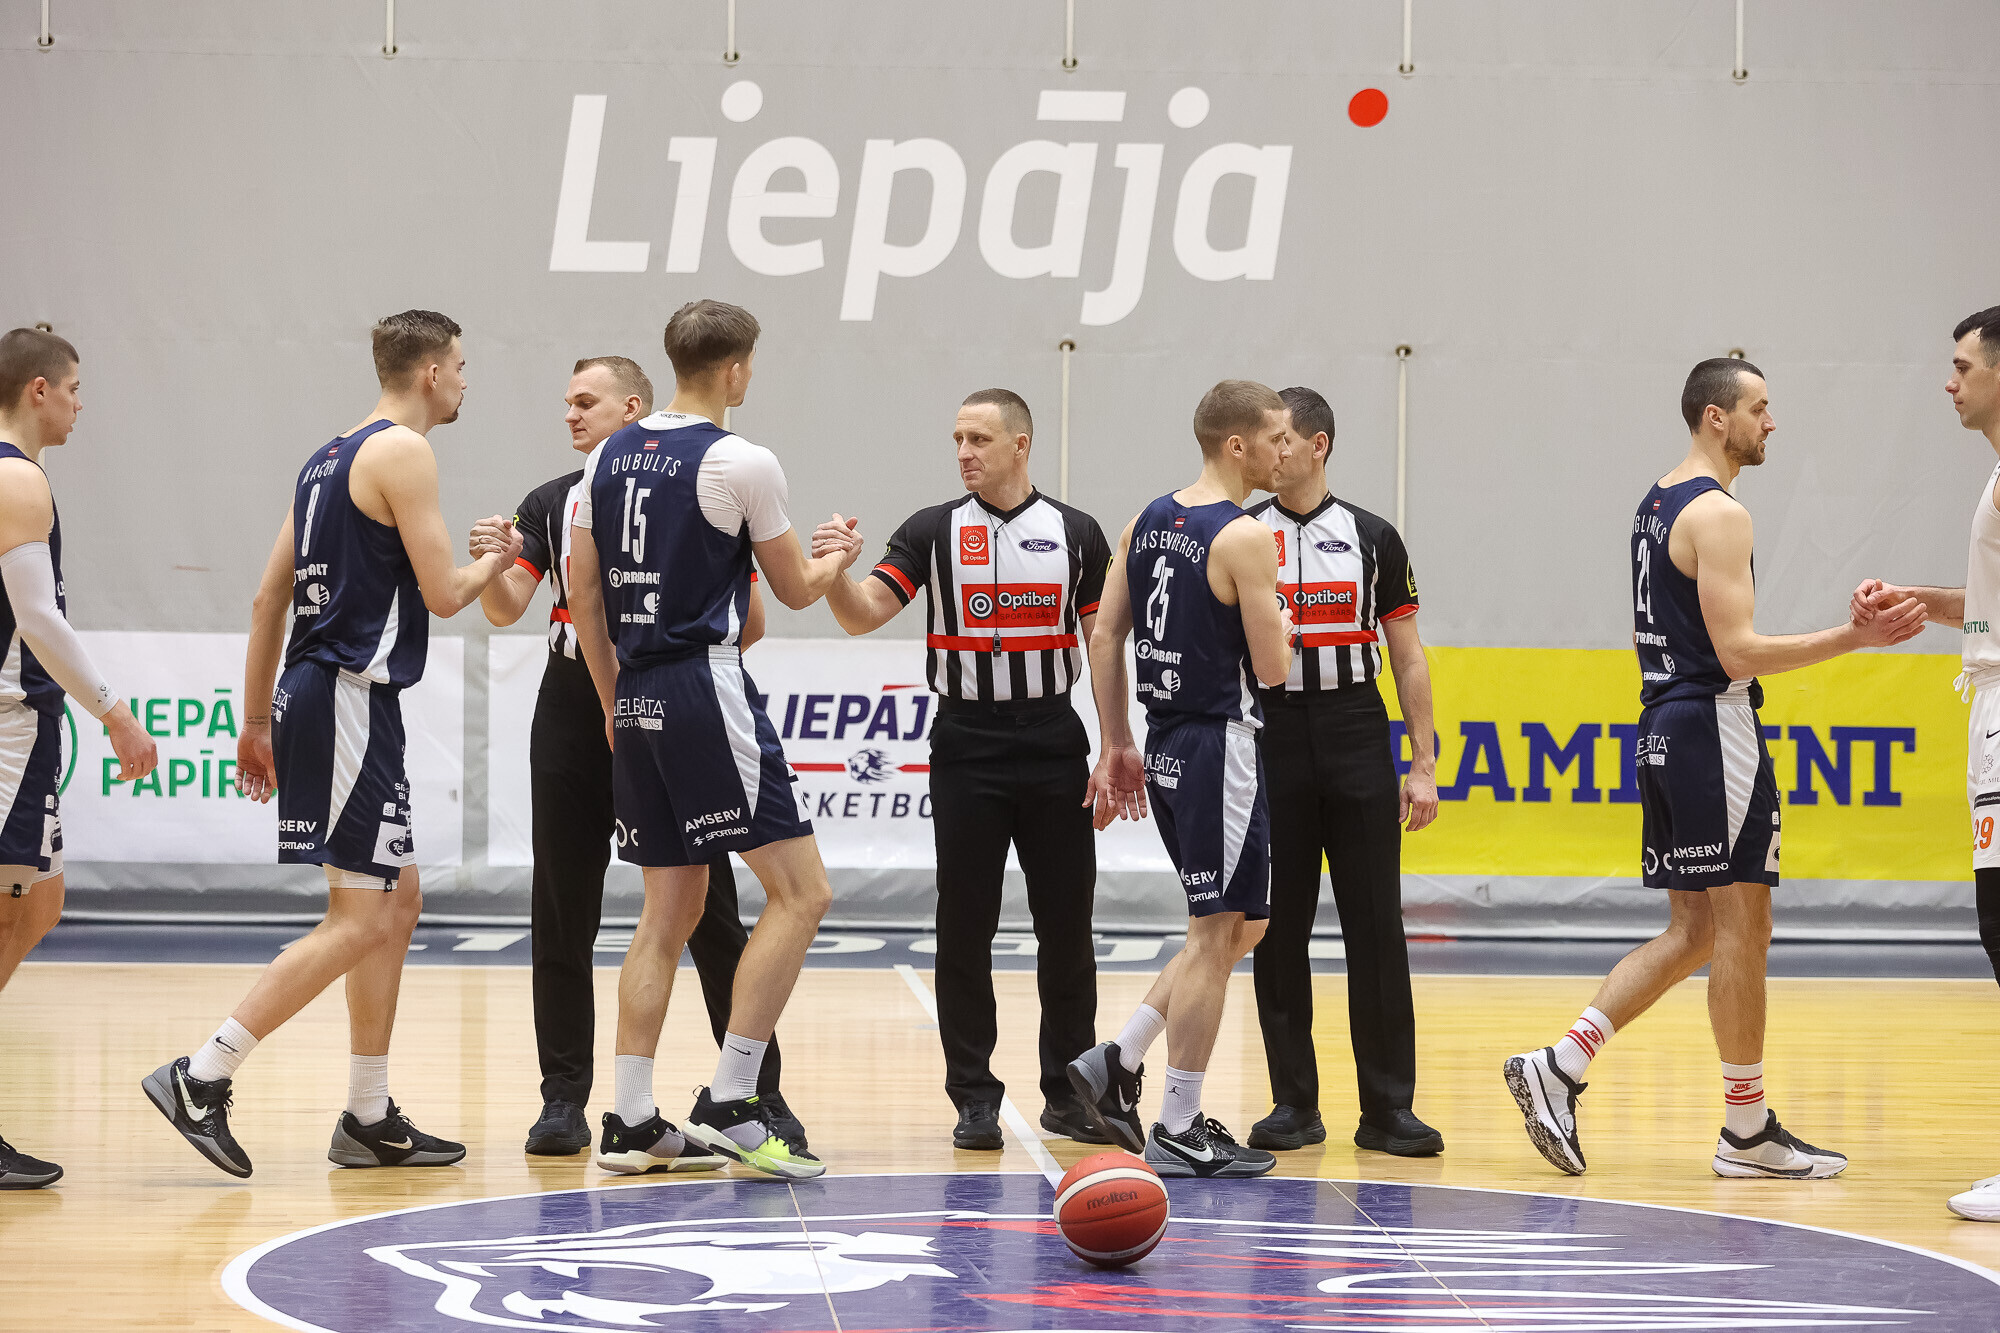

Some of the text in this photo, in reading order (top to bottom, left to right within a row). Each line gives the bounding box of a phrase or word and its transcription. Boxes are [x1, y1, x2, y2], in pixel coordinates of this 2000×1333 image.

[549, 80, 1294, 327] Liepāja
[611, 453, 682, 477] DUBULTS
[621, 477, 652, 564] 15
[1027, 540, 1052, 551] Ford
[1321, 542, 1346, 552] Ford
[998, 591, 1057, 611] Optibet
[1146, 555, 1175, 642] 25
[1293, 589, 1352, 608] Optibet
[1000, 612, 1031, 620] SPORTA
[1294, 608, 1351, 618] SPORTA BĀRS
[103, 688, 238, 738] EPĀ
[759, 684, 934, 741] IEPĀJ
[102, 750, 277, 798] PAPĪR
[279, 819, 317, 833] SERV
[685, 807, 741, 833] AMSERV
[705, 826, 749, 841] SPORTLAND
[1973, 816, 1994, 850] 29
[1673, 842, 1723, 859] AMSERV
[1181, 868, 1217, 886] SERV
[1686, 862, 1729, 874] SPORTLAND
[1086, 1190, 1139, 1211] molten
